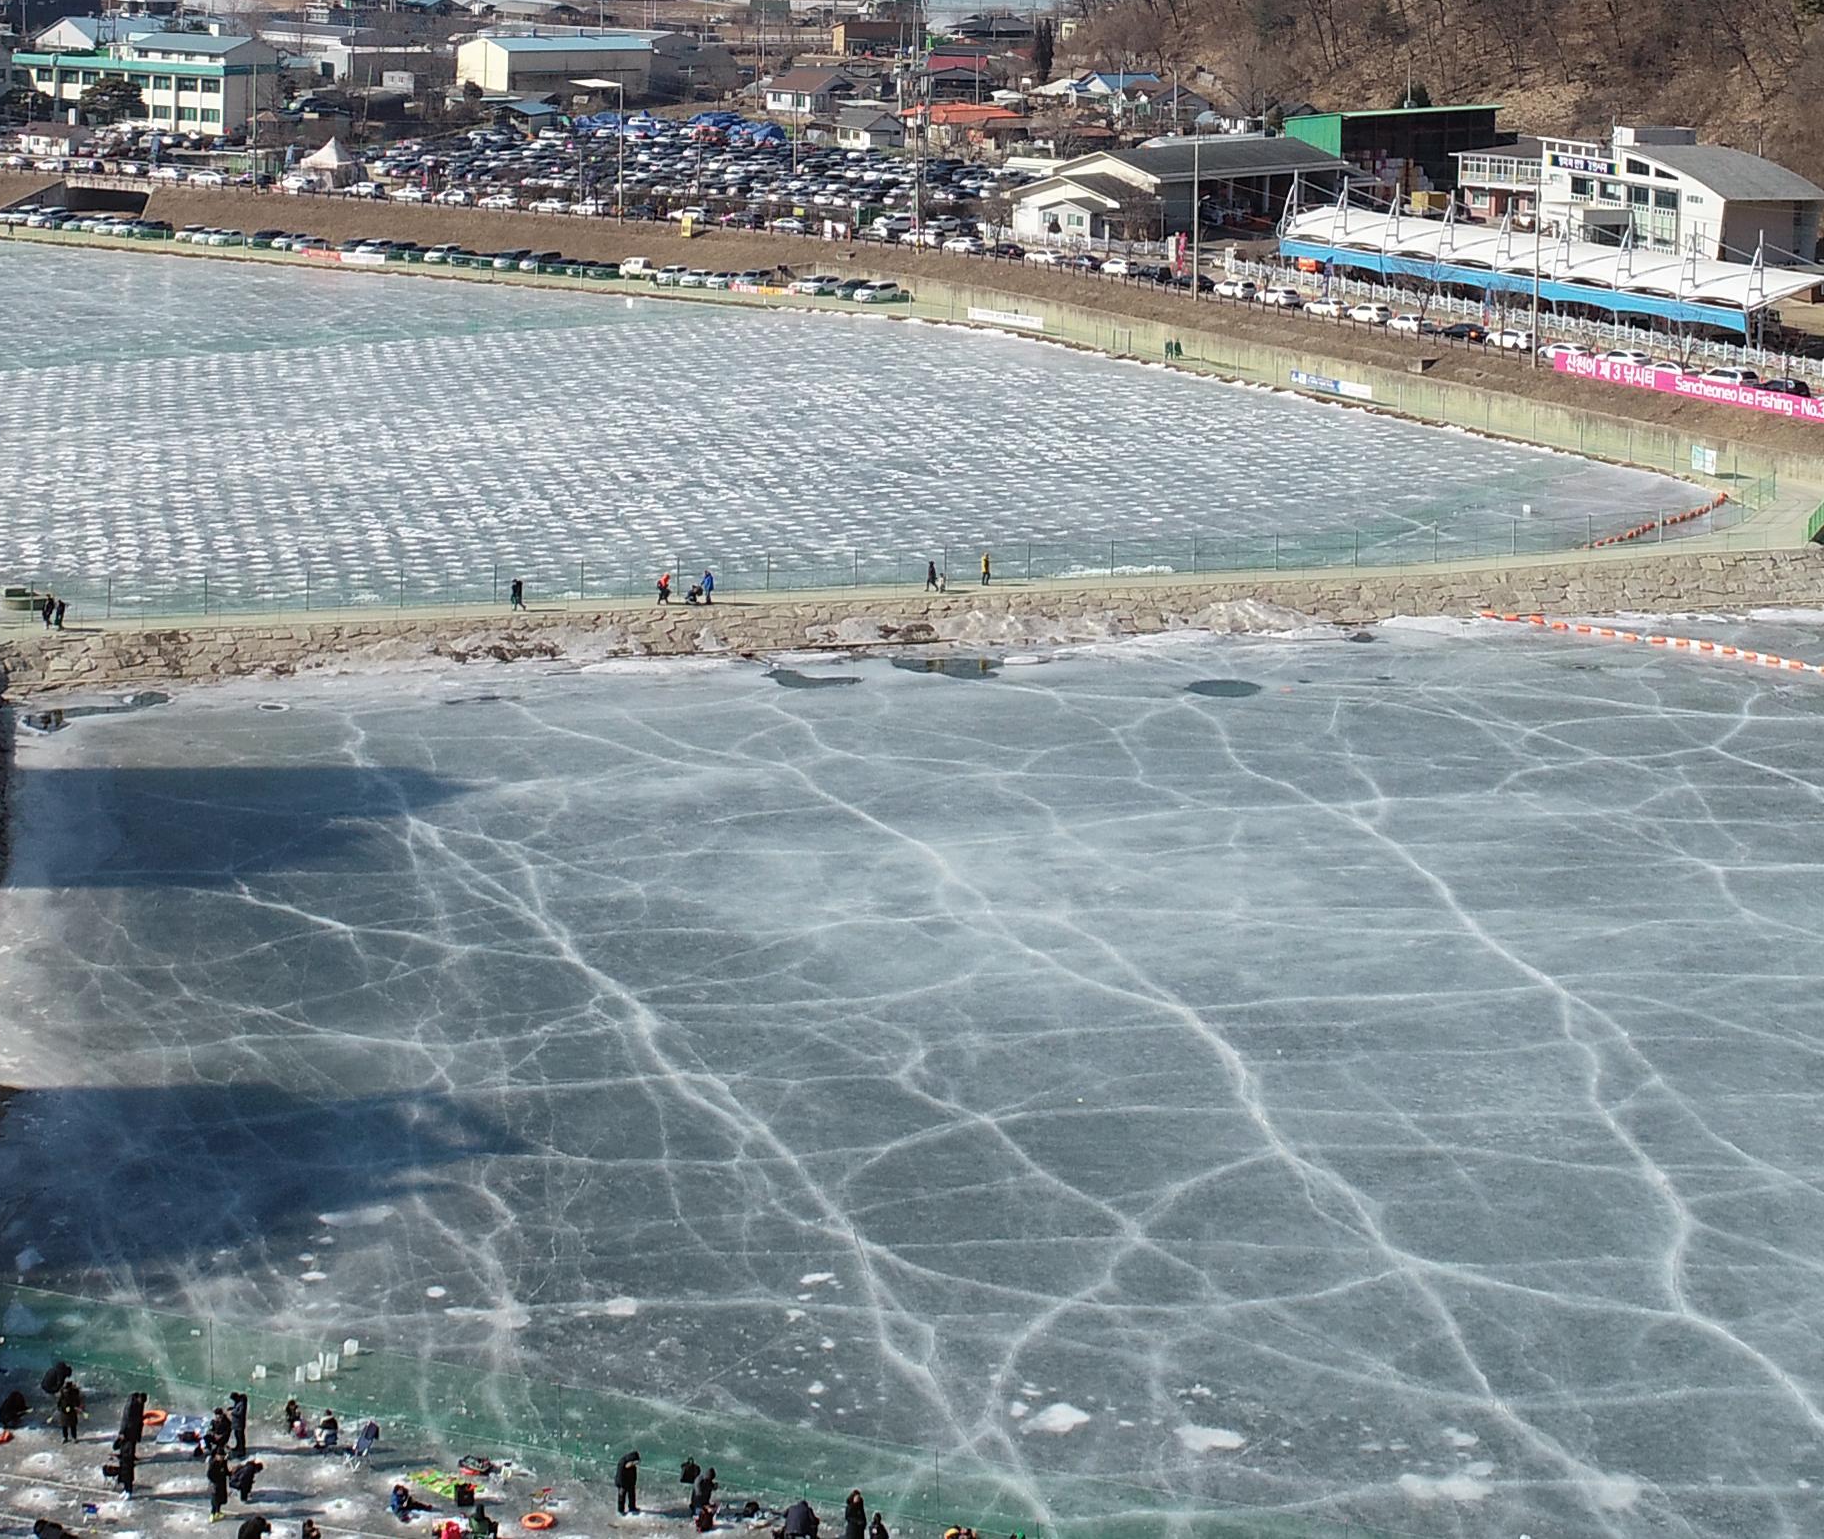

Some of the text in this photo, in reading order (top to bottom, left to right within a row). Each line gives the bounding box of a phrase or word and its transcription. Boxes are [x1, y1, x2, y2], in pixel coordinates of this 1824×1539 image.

[1566, 354, 1596, 376] 산천어
[1612, 364, 1621, 380] 3
[1623, 366, 1655, 387] 낚시터
[1675, 375, 1737, 402] Sancheoneo
[1737, 387, 1754, 405] Ice
[1754, 389, 1793, 415] Fishing
